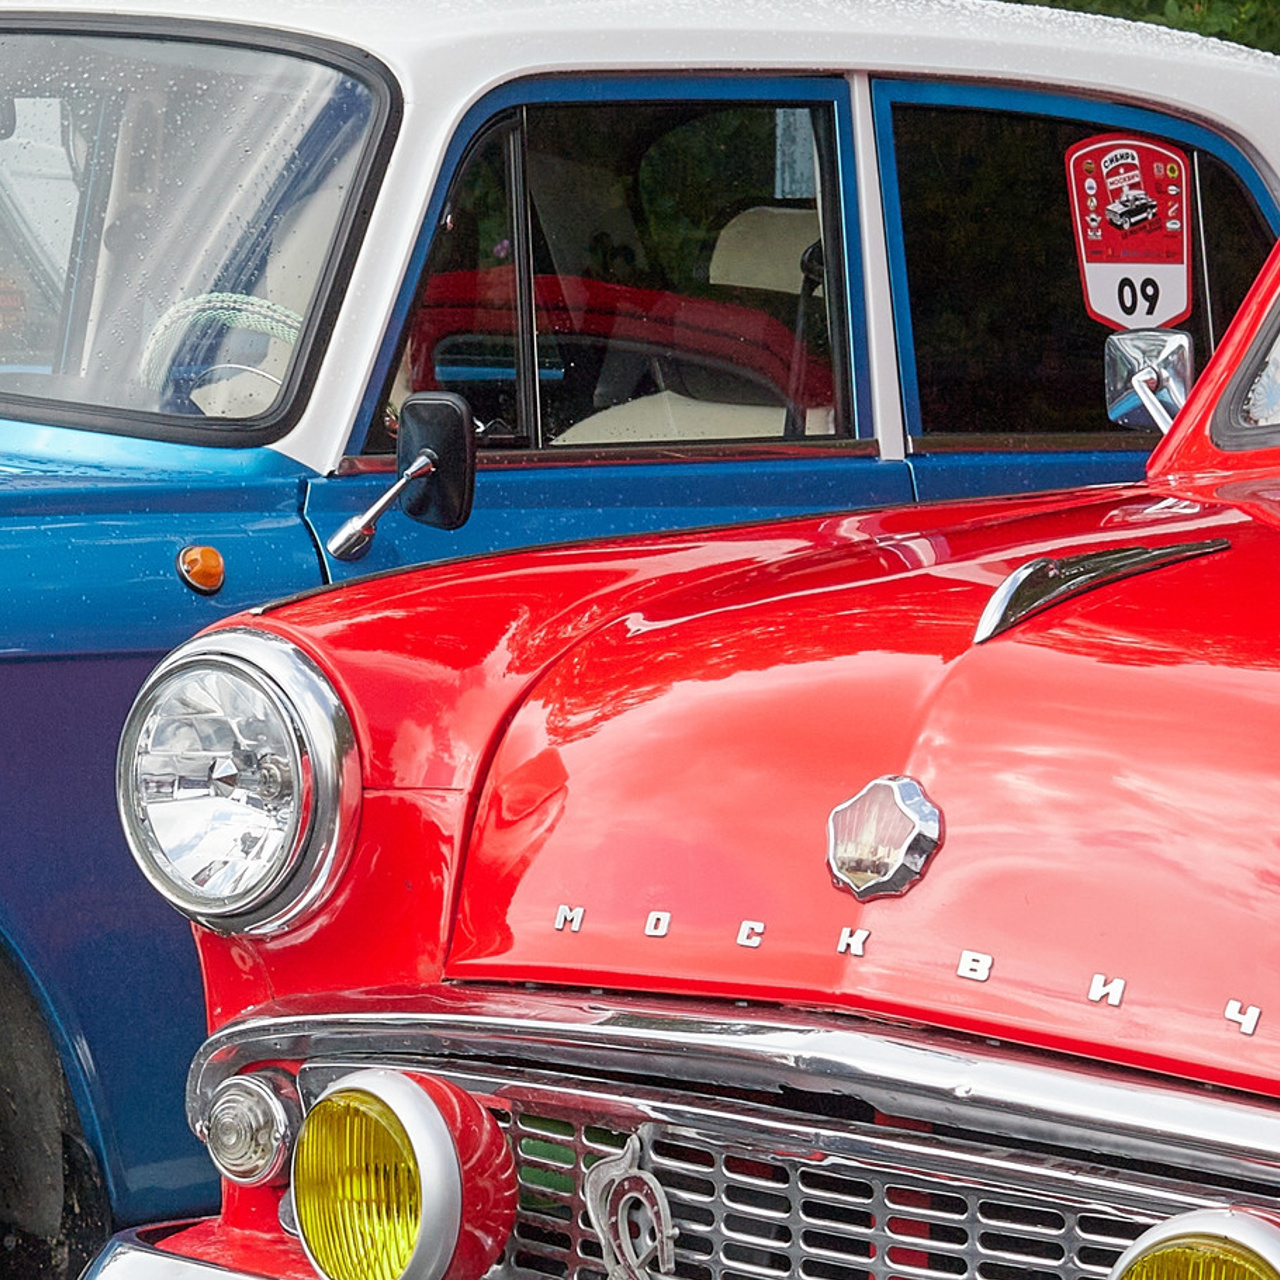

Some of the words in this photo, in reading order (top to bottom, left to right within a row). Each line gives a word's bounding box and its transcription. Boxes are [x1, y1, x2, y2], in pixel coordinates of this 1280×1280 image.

[1103, 151, 1136, 169] СИБИРЬ
[1117, 277, 1160, 316] 09
[554, 904, 1262, 1035] МОСКВИЧ
